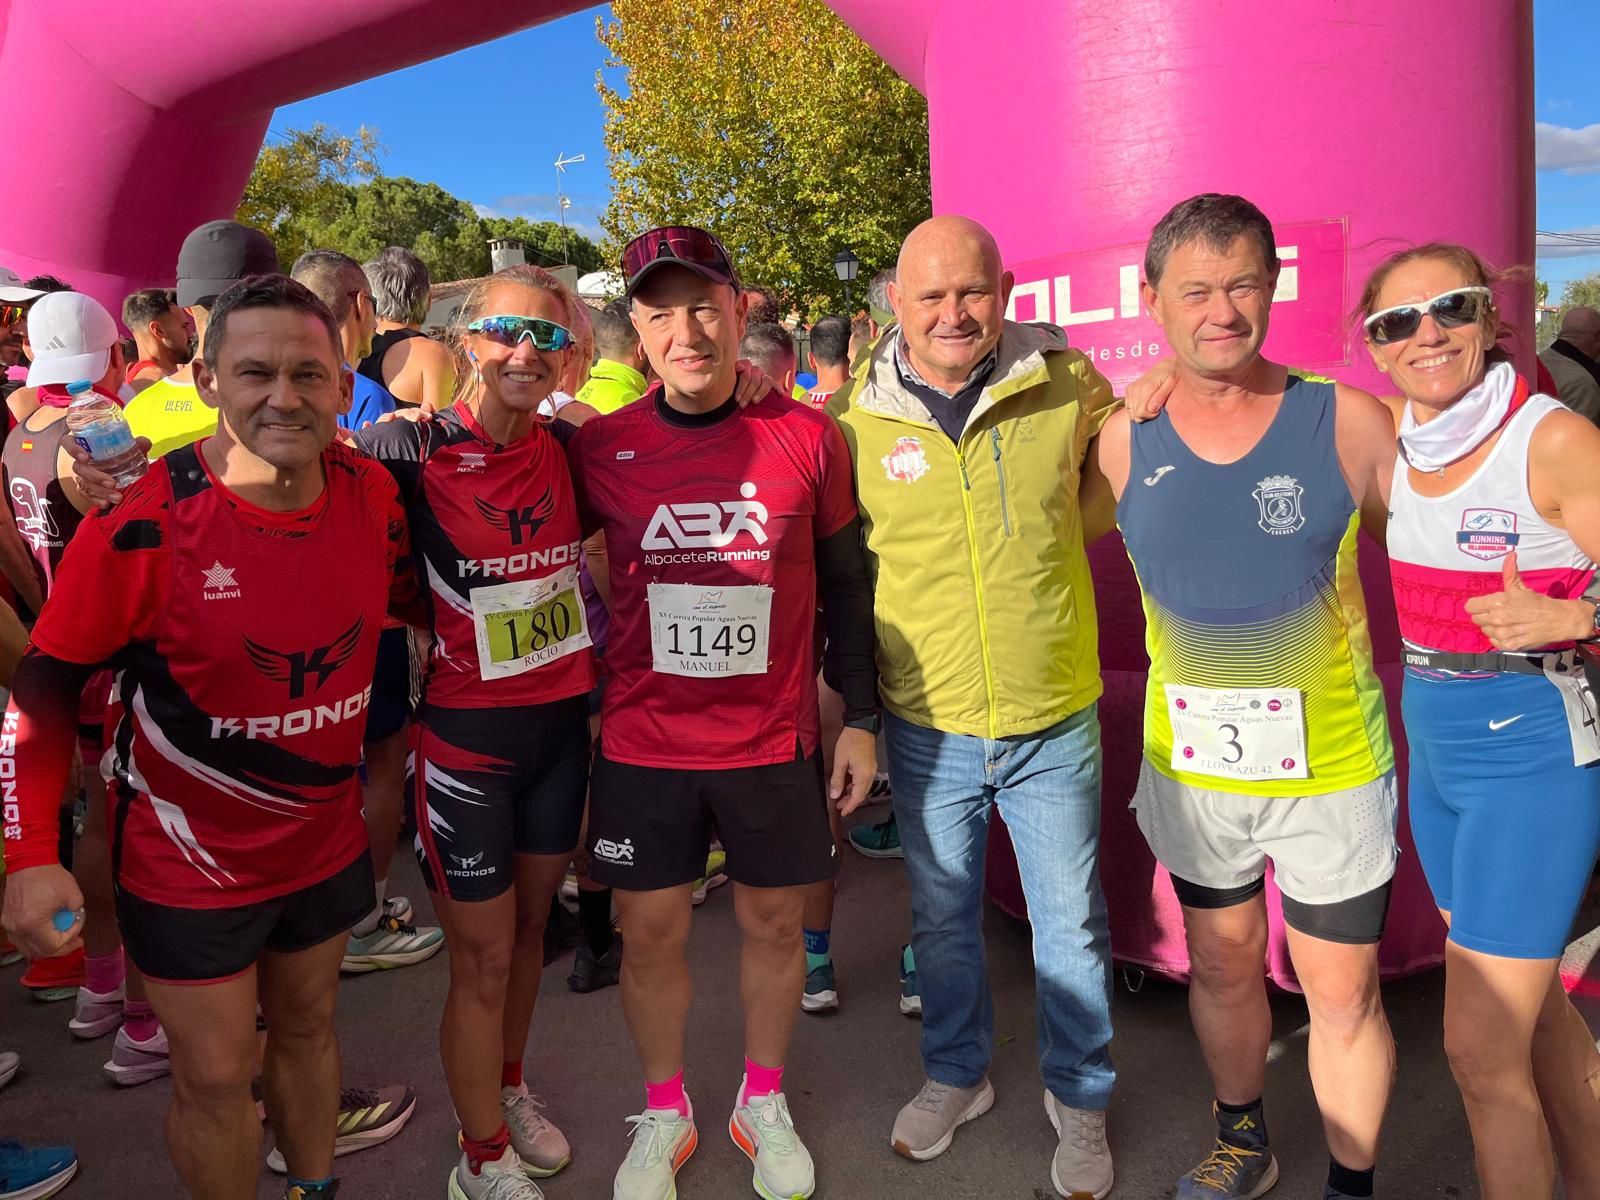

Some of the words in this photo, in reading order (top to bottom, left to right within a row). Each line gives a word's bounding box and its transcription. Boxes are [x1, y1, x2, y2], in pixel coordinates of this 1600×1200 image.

[1084, 340, 1160, 362] desde
[1470, 535, 1506, 544] RUNNING
[456, 541, 580, 578] KRONOS
[644, 549, 770, 565] AlbaceteRunning
[497, 611, 522, 619] Carrera
[504, 602, 570, 660] 180
[668, 623, 755, 657] 1149
[680, 660, 732, 672] MANUEL
[1211, 714, 1237, 724] Popular
[1218, 723, 1243, 763] 3
[1207, 760, 1234, 771] LOVE
[1236, 766, 1258, 775] AZU
[1260, 765, 1273, 774] 42
